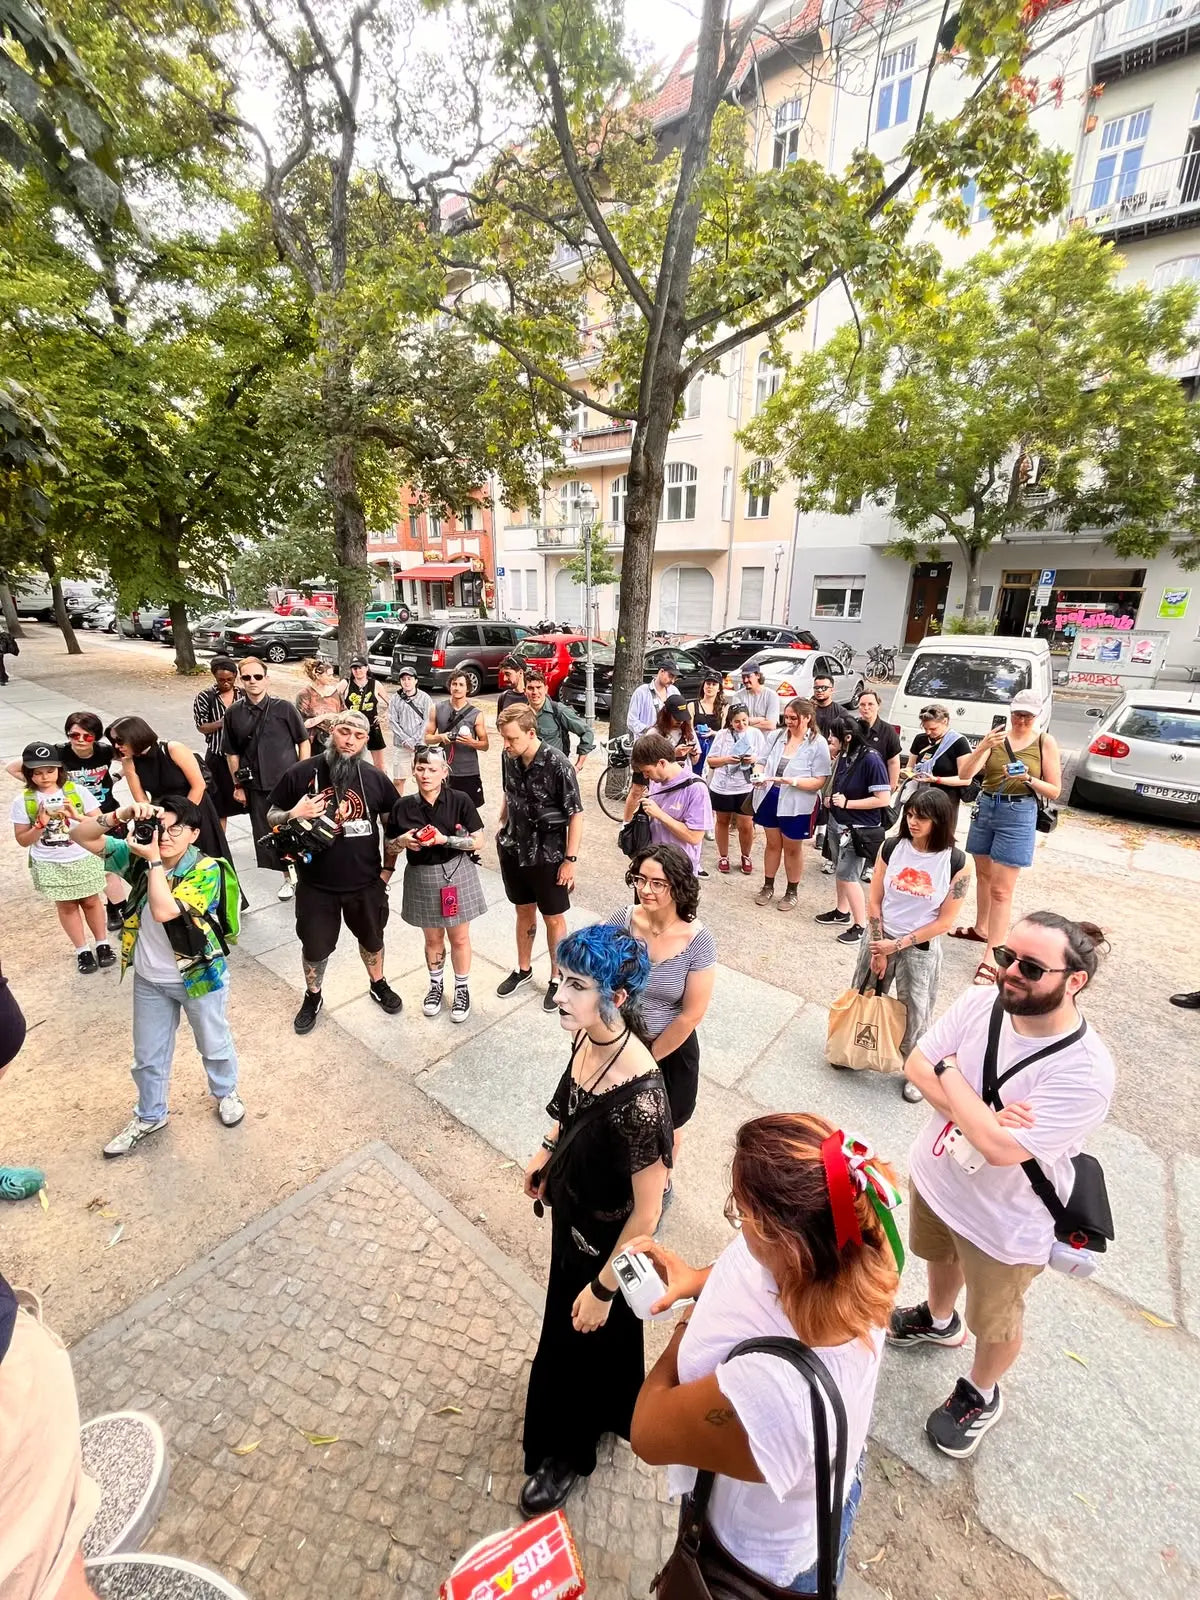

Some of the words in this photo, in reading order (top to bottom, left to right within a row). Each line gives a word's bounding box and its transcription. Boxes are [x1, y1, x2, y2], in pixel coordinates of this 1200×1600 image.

[1042, 571, 1052, 584] P
[1143, 785, 1149, 793] B
[1155, 787, 1168, 797] PB
[1170, 790, 1197, 801] 2230
[495, 1541, 552, 1593] RISA
